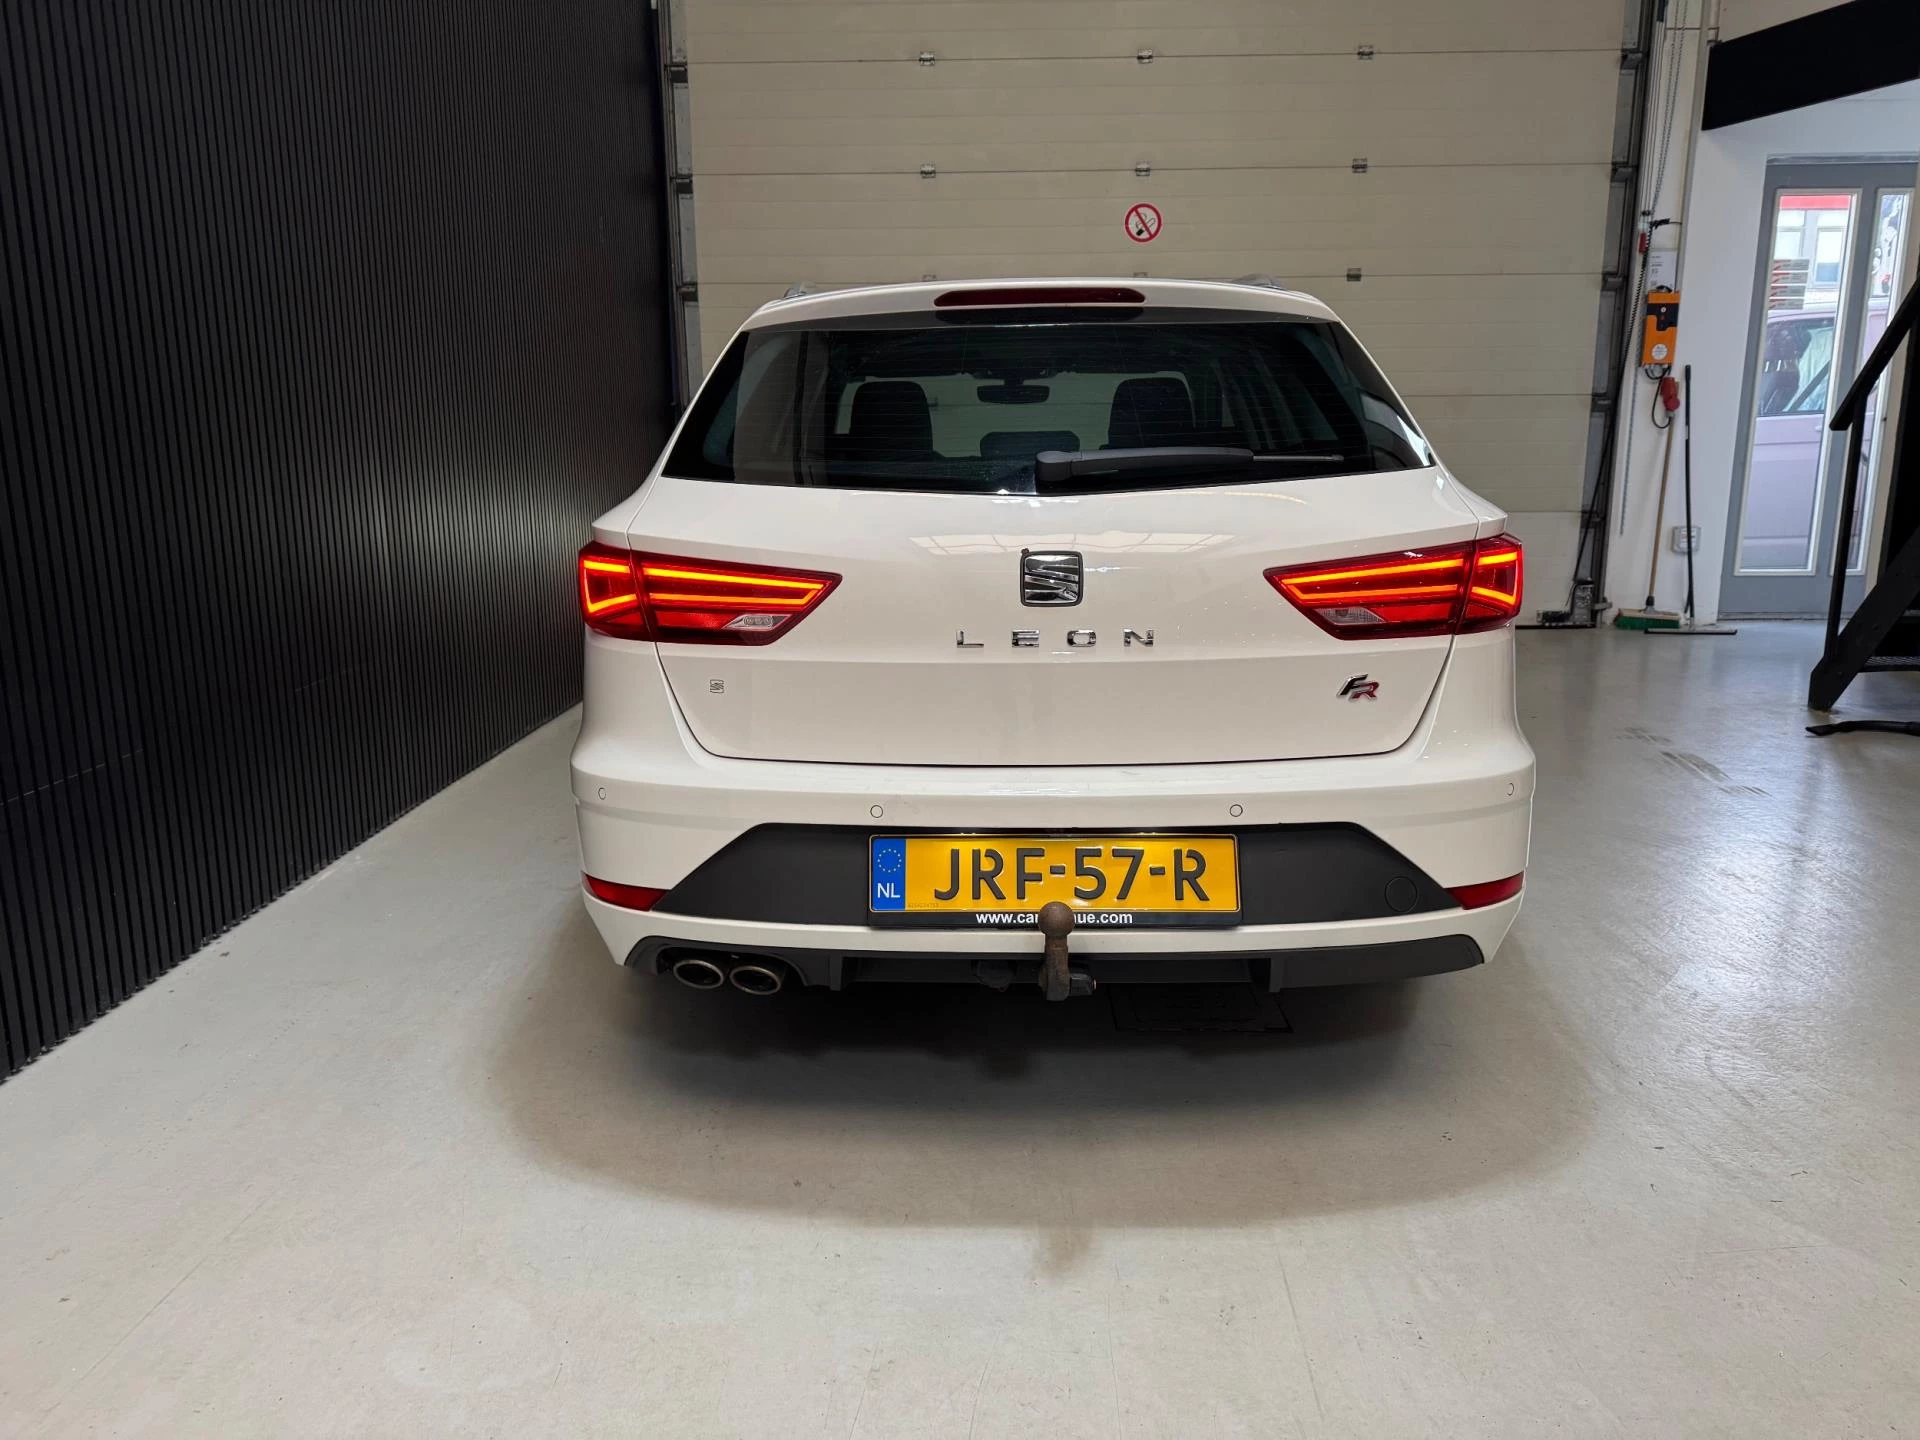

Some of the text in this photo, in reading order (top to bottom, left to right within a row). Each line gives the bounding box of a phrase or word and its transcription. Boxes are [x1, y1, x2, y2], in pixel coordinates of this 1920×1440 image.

[956, 629, 1154, 648] LEON
[1336, 673, 1380, 702] FR
[934, 847, 1210, 901] JRF-57-R
[877, 882, 901, 899] NL
